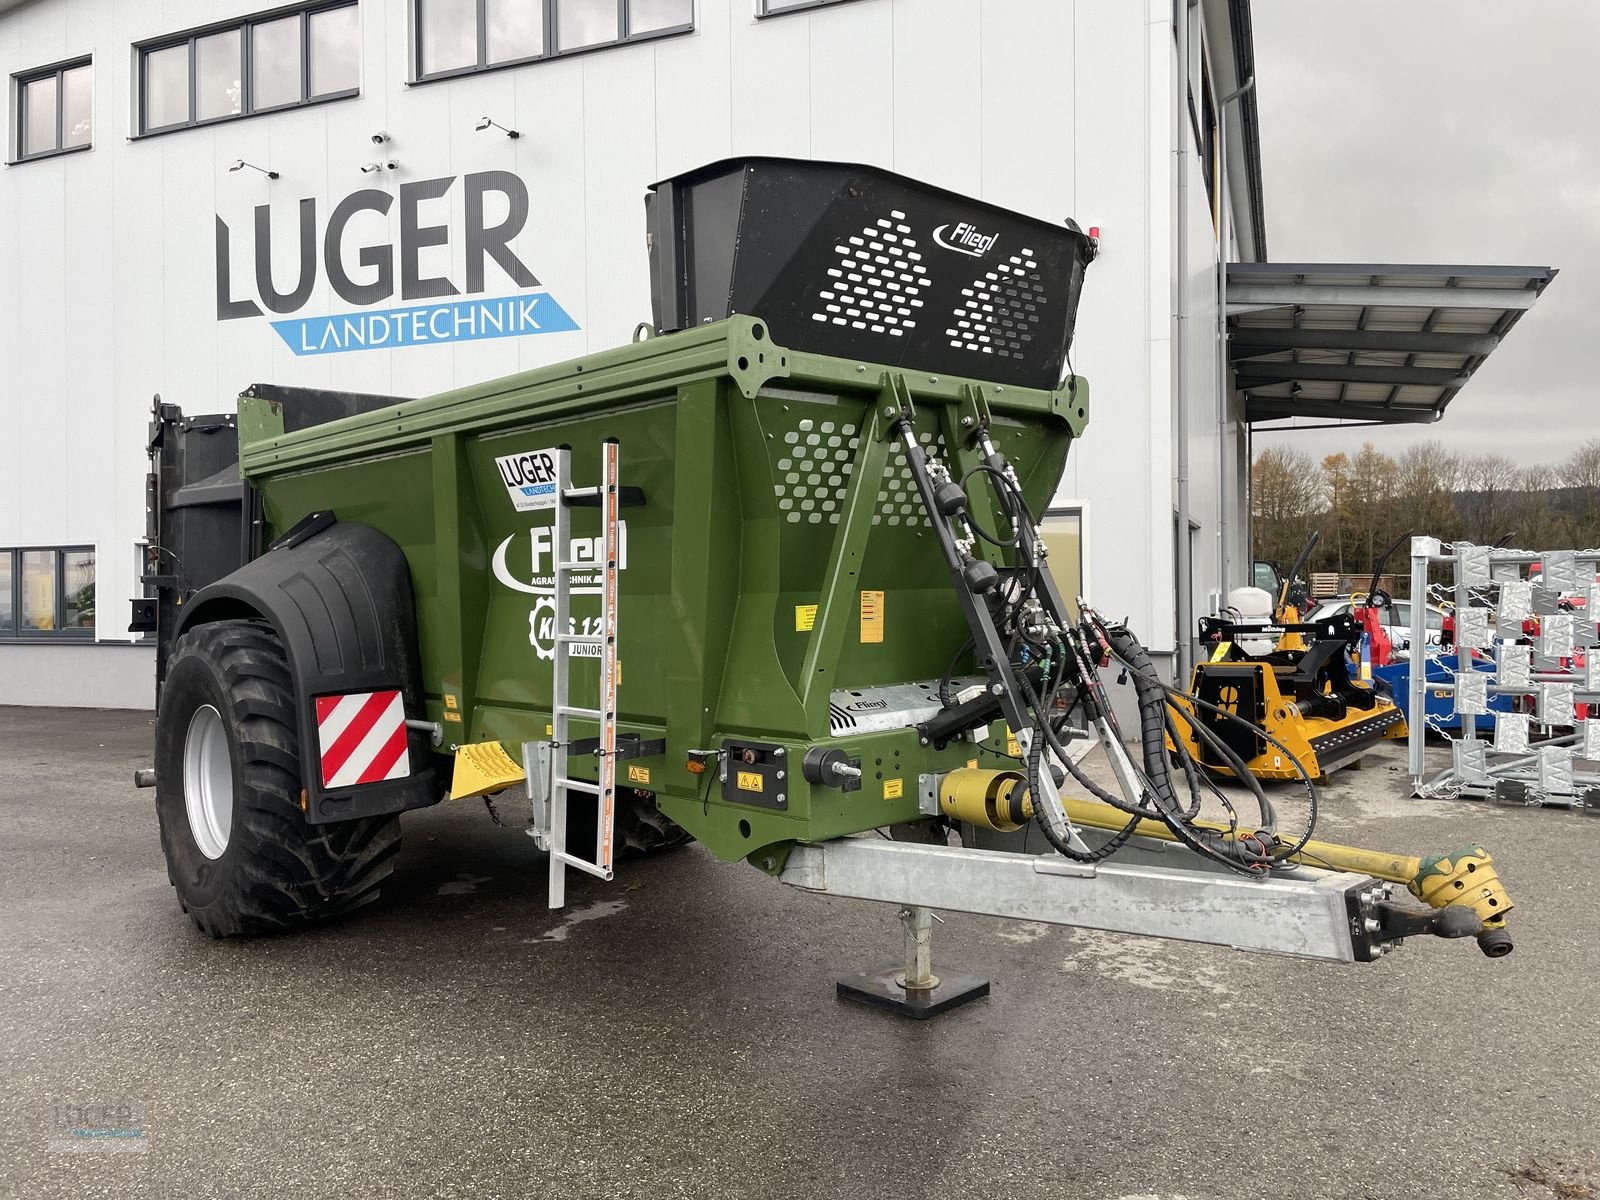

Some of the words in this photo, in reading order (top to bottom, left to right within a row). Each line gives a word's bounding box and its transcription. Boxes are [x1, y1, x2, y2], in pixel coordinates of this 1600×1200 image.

[215, 170, 543, 321] LUGER
[949, 222, 1000, 254] Fliegl
[301, 299, 541, 352] LANDTECHNIK
[499, 453, 557, 487] LUGER
[572, 644, 603, 656] JUNIOR
[855, 699, 888, 709] Fliegl
